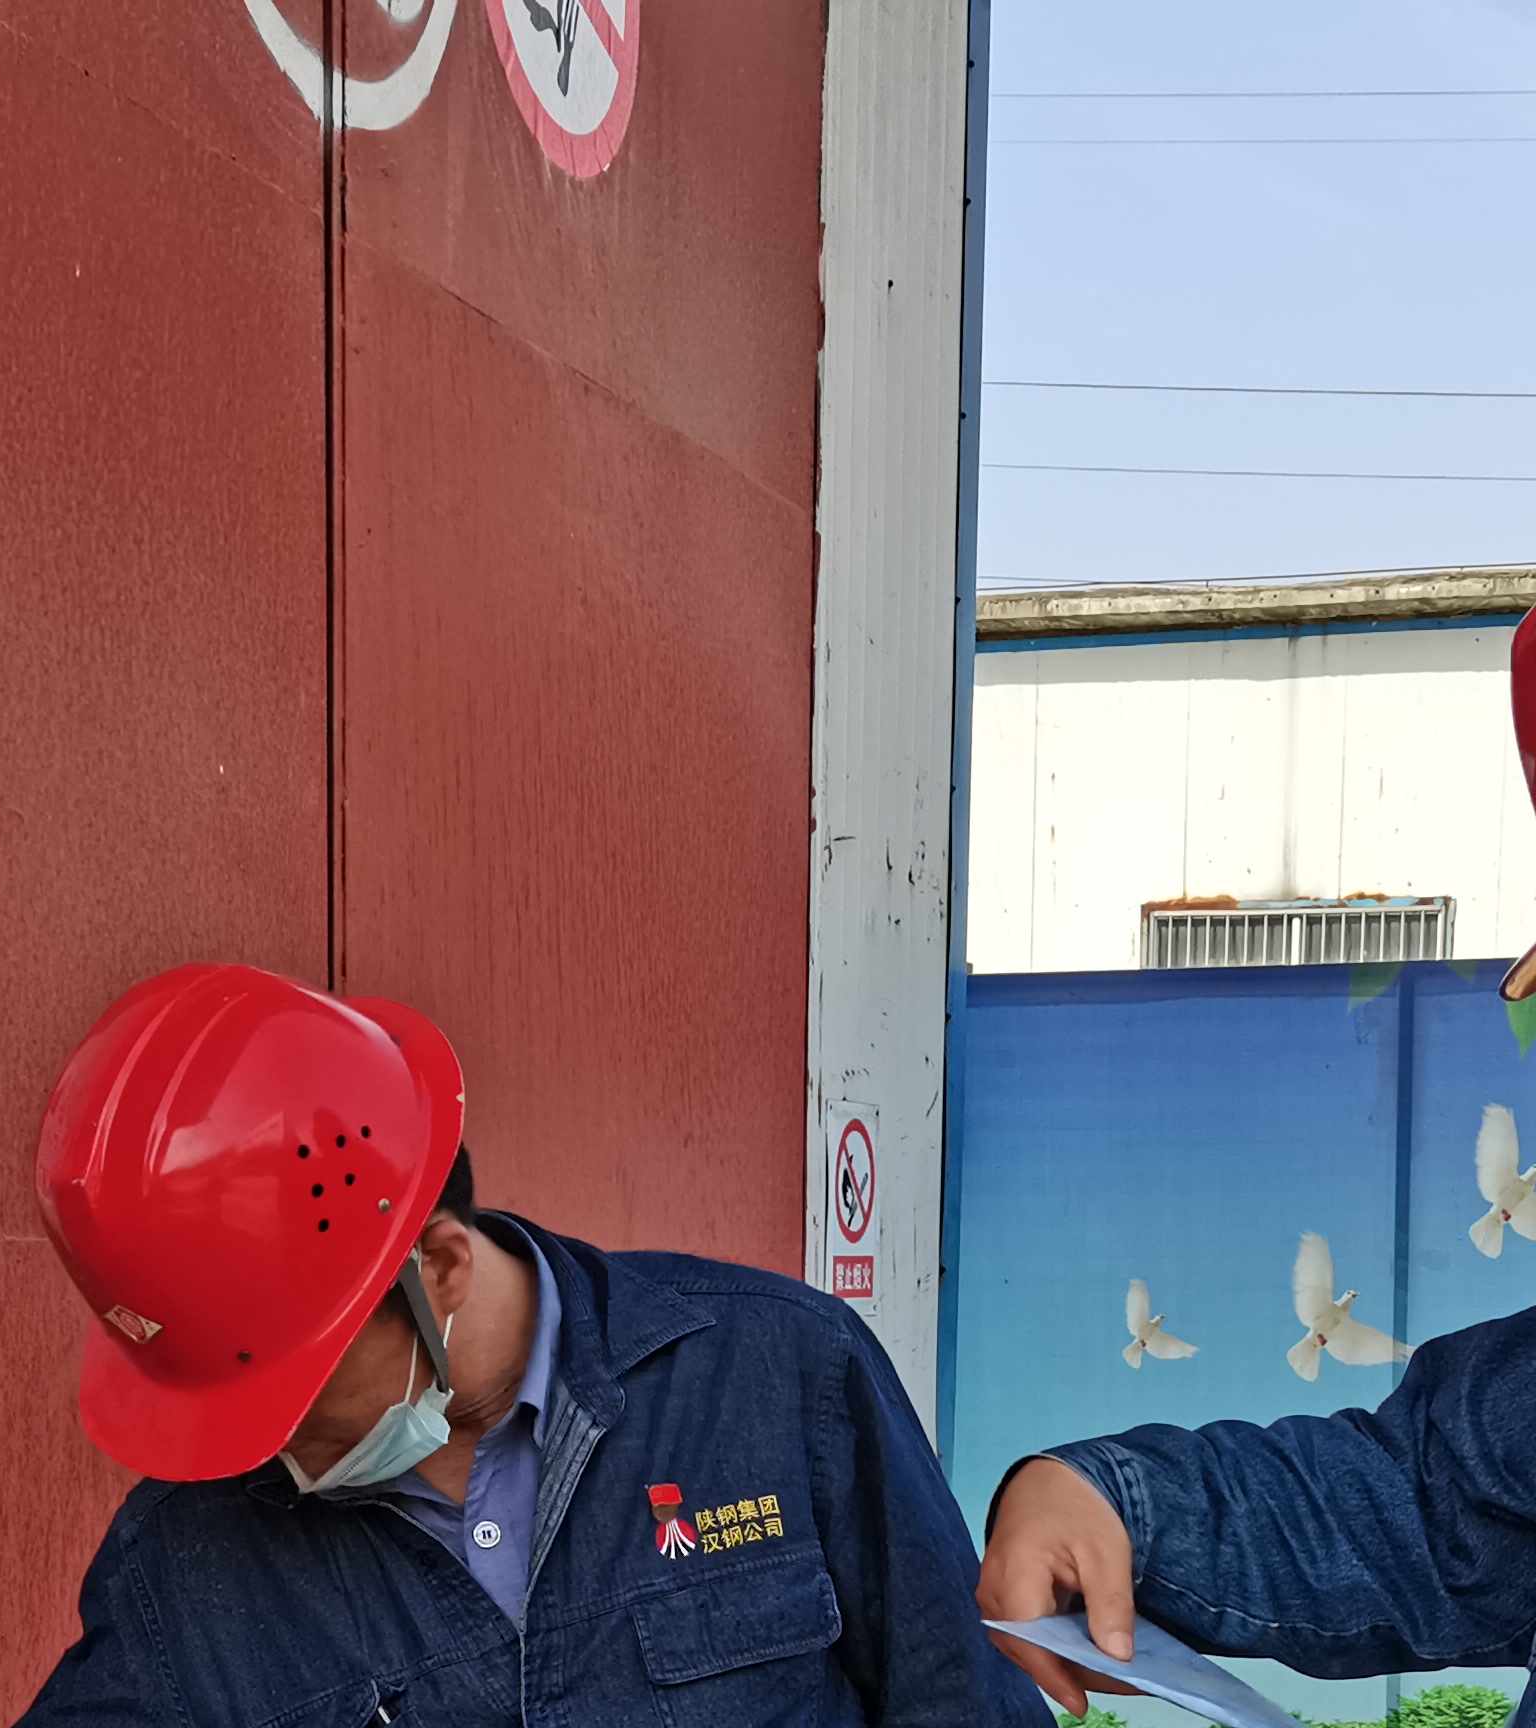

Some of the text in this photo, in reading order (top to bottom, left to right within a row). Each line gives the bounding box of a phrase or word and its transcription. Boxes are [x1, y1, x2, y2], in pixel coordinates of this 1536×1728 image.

[836, 1263, 871, 1290] 禁止烟火
[695, 1494, 780, 1533] 陕钢集团
[700, 1517, 784, 1554] 汉钢公司
